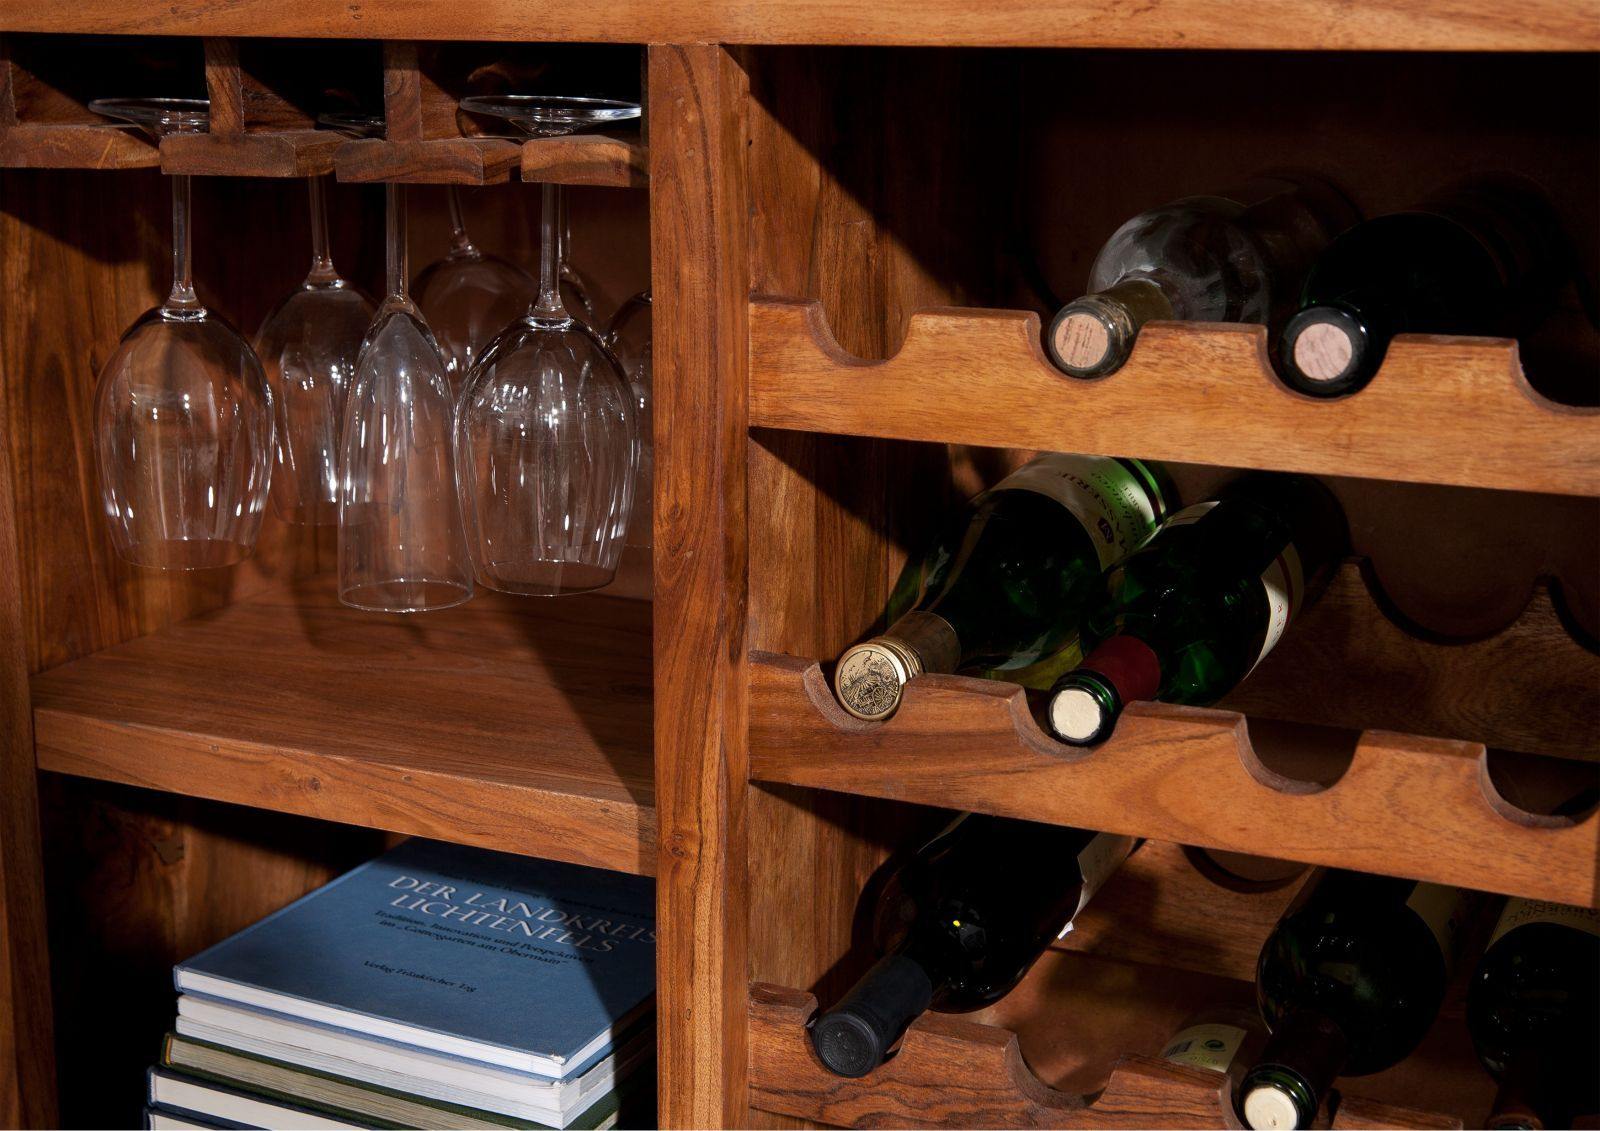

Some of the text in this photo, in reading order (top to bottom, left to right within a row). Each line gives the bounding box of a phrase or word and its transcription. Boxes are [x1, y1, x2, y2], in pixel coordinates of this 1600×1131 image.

[388, 875, 457, 900] DER
[463, 892, 656, 944] LANDKREIS
[390, 894, 620, 953] LICHTENFELS
[430, 922, 492, 942] Innovation
[494, 936, 520, 948] und
[476, 942, 497, 952] am
[363, 959, 395, 975] Verlag
[457, 982, 478, 994] Tag
